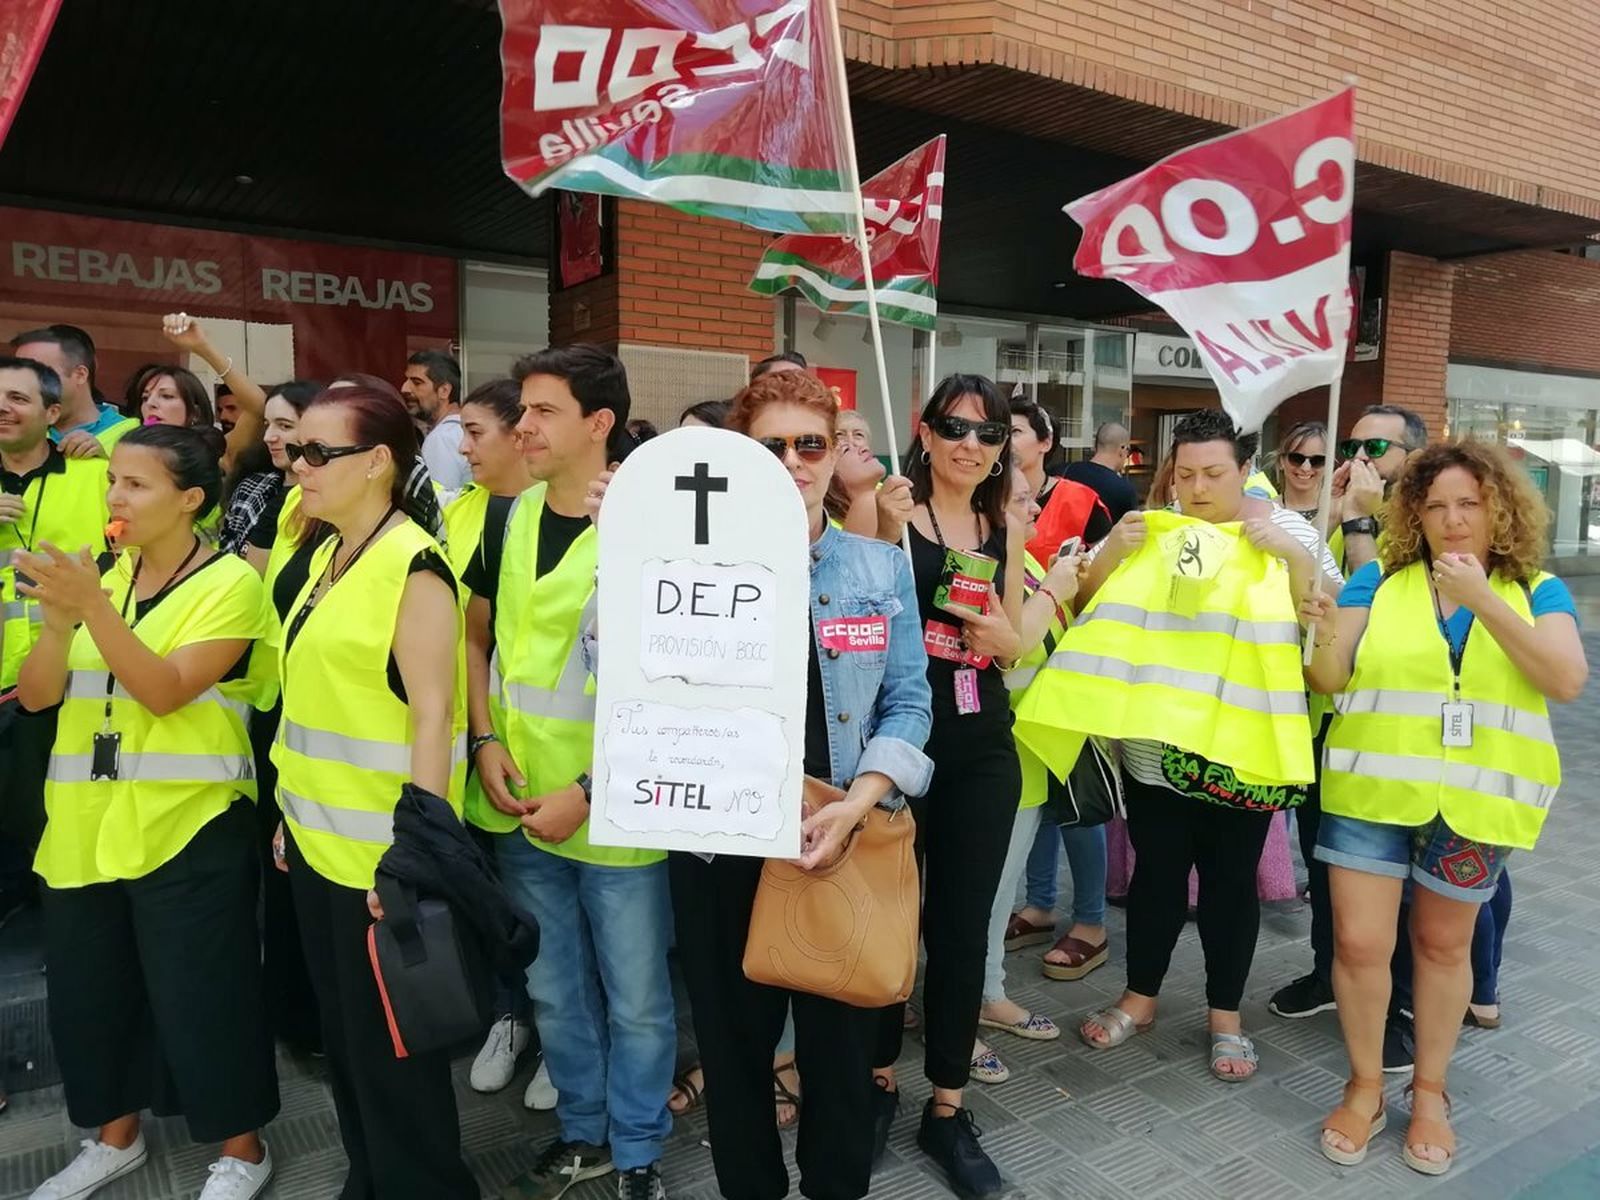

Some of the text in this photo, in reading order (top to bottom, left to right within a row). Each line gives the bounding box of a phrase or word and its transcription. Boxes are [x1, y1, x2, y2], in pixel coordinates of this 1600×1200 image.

[11, 240, 435, 315] REBAJAS REBAJAS
[656, 579, 763, 622] D.E.P.
[648, 633, 727, 660] PROVISIÓN
[849, 635, 886, 646] Sevilla
[616, 703, 648, 735] Tus
